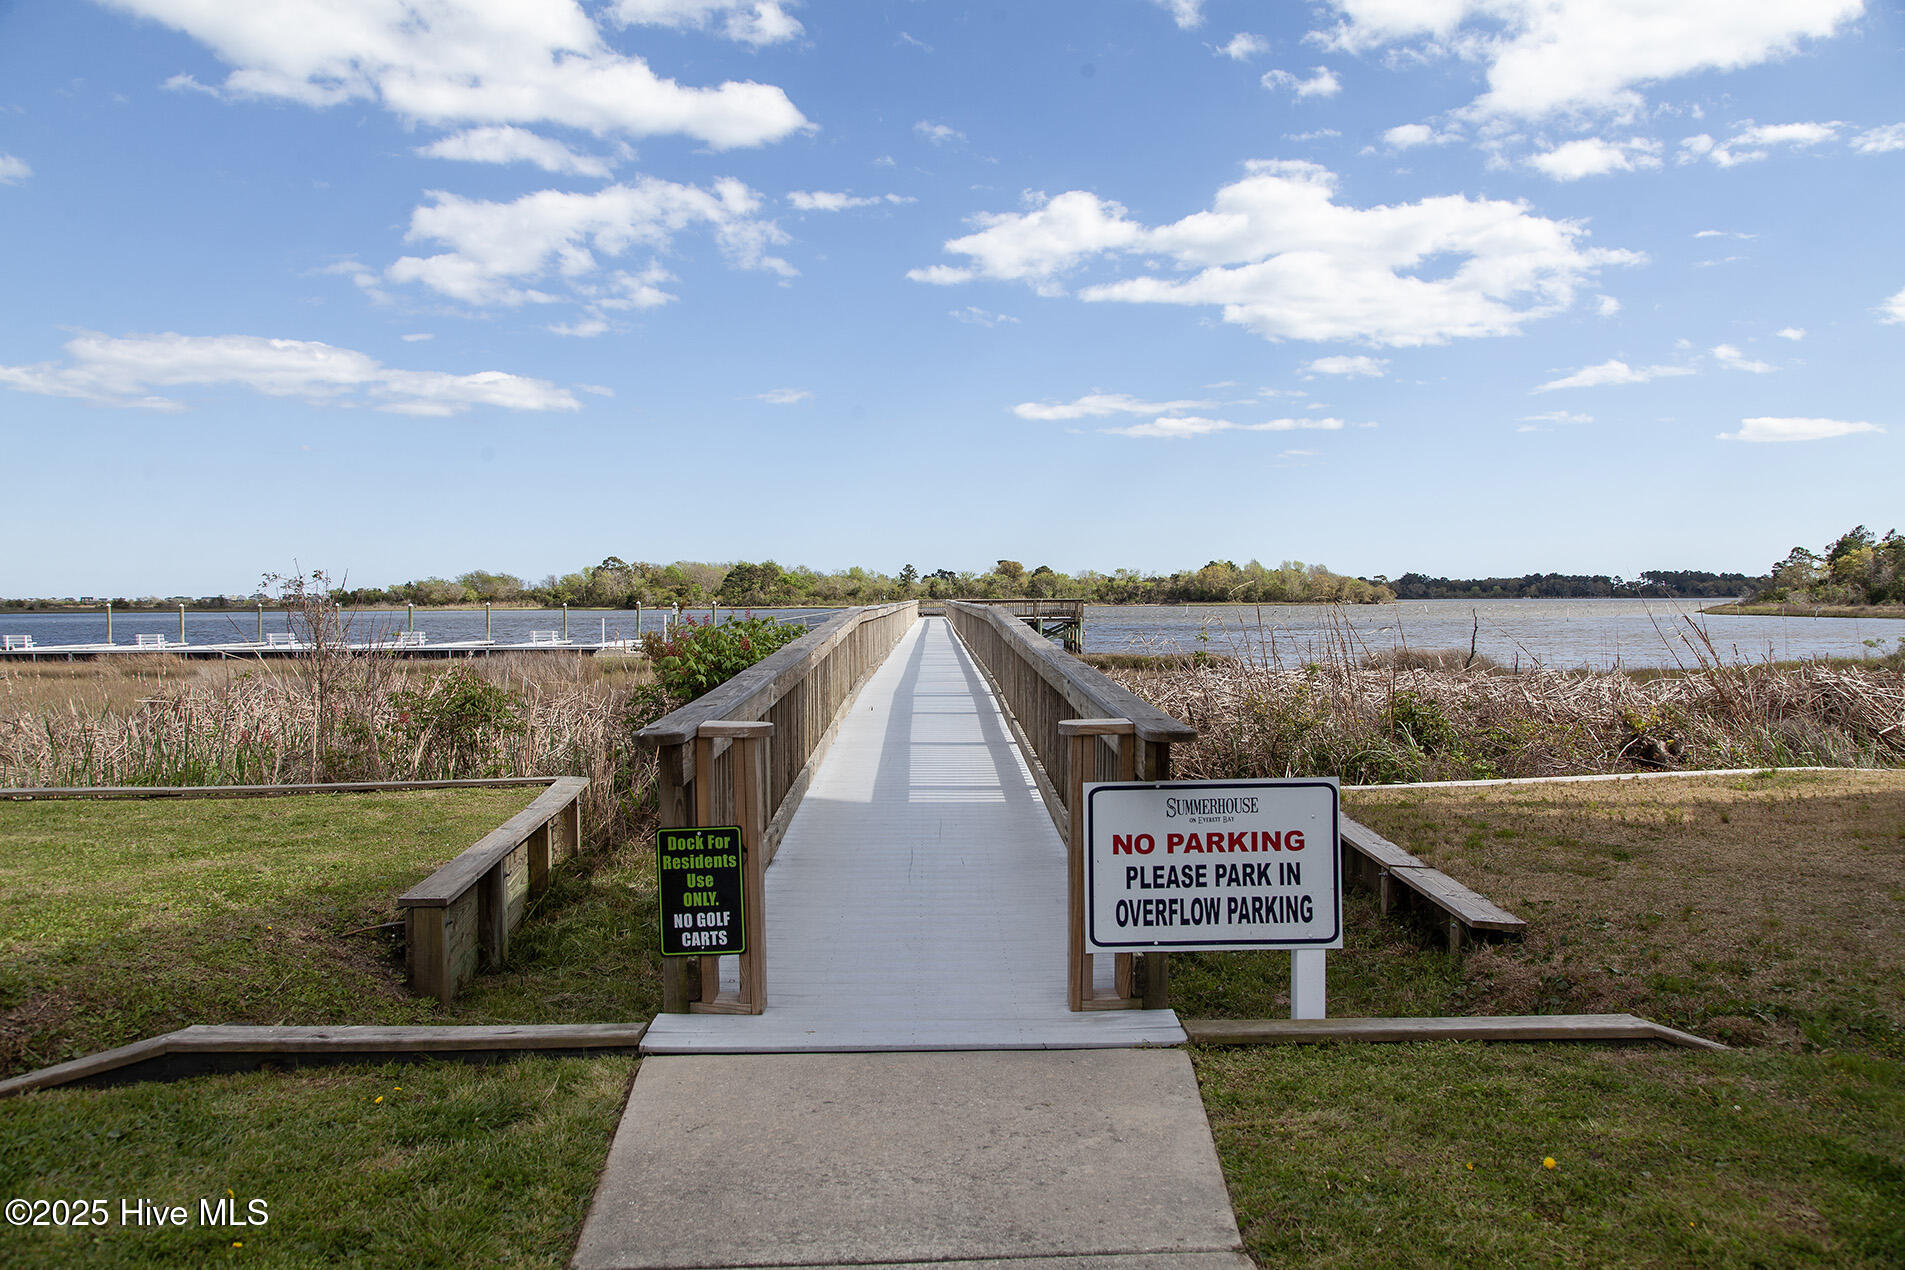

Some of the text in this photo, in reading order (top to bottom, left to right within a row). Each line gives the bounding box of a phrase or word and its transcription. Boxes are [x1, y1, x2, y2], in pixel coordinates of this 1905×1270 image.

[1166, 797, 1259, 818] SUMMERHOUSE
[667, 834, 731, 850] Dock For
[1112, 830, 1306, 855] NO PARKING
[662, 854, 737, 870] Residents
[686, 873, 714, 888] Use
[1126, 861, 1301, 890] PLEASE PARK IN
[683, 891, 720, 907] ONLY.
[673, 911, 731, 928] NO GOLF
[1116, 894, 1313, 928] OVERFLOW PARKING
[681, 930, 728, 947] CARTS
